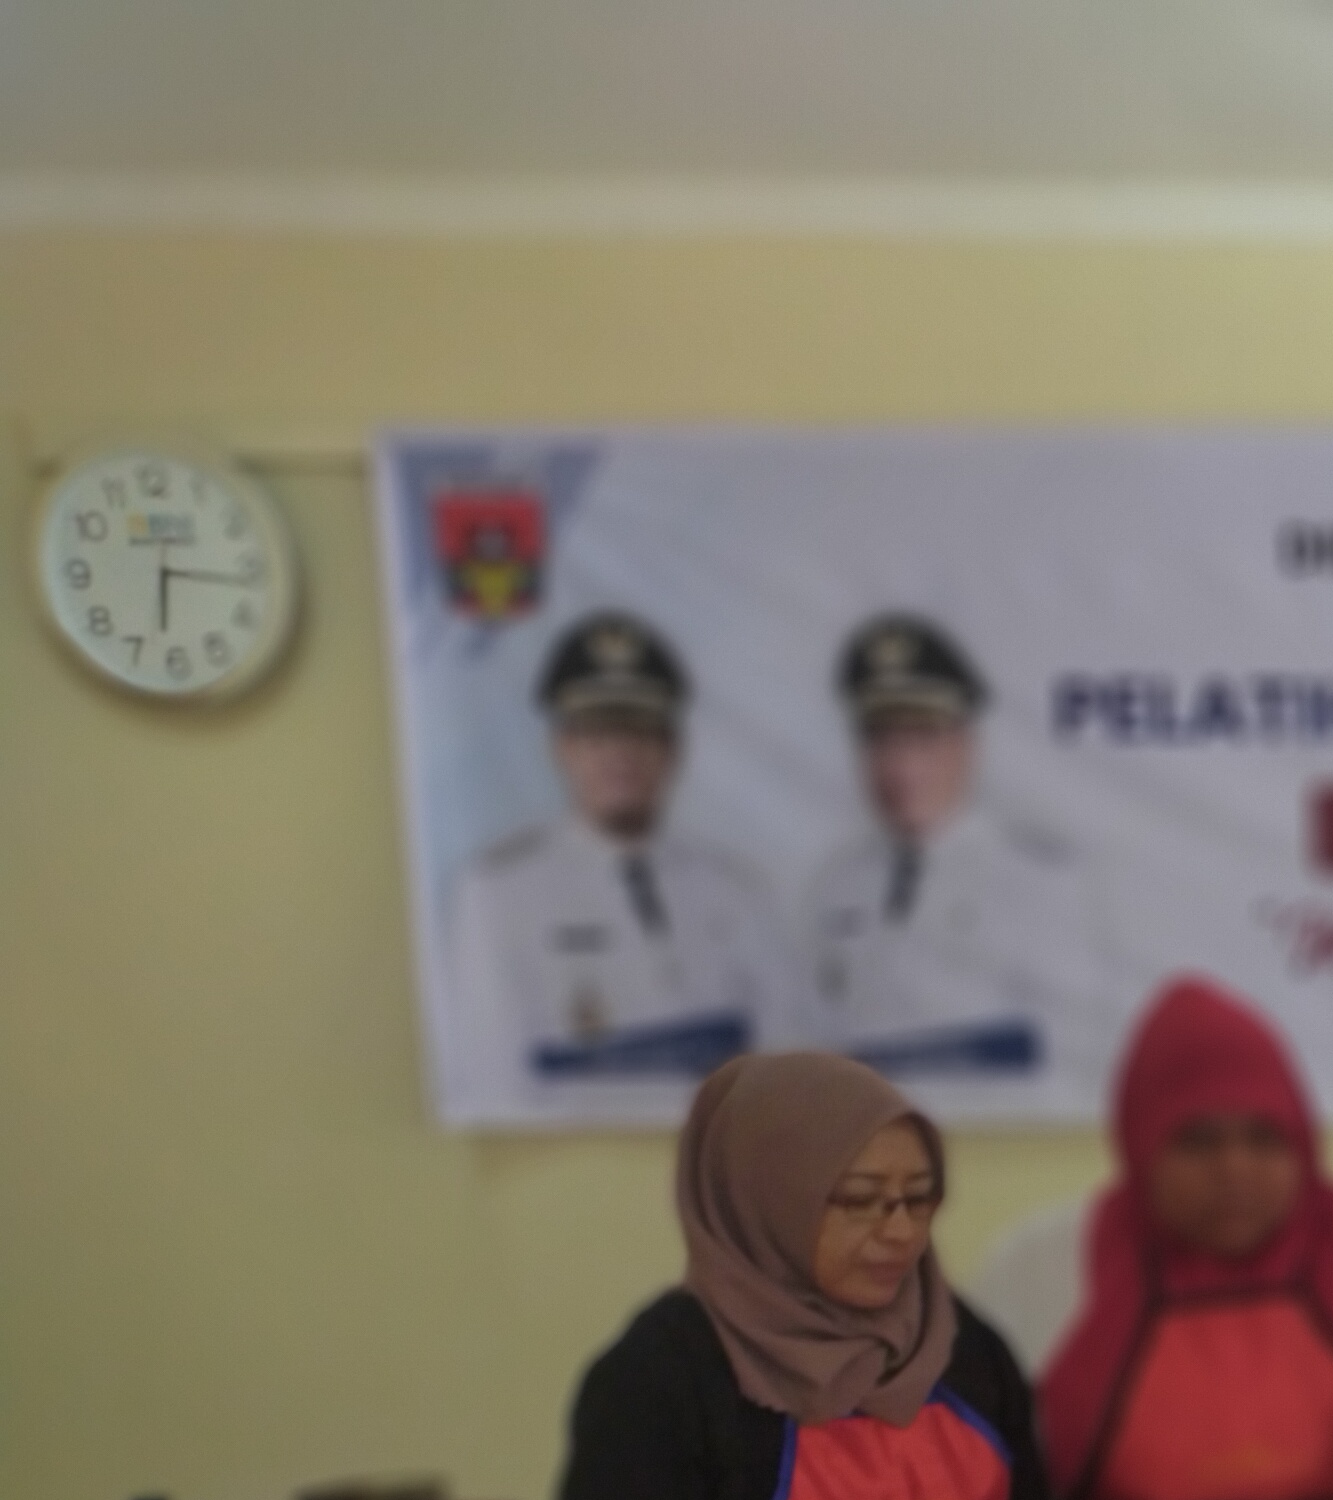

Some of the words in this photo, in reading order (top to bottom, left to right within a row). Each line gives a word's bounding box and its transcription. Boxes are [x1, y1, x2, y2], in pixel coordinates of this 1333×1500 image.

[101, 475, 128, 509] 11
[134, 461, 171, 499] 12
[74, 508, 109, 543] 10
[221, 503, 249, 541] 2
[63, 556, 92, 592] 9
[87, 604, 114, 638] 8
[230, 600, 258, 632] 4
[121, 633, 145, 669] 7
[163, 645, 194, 682] 6
[203, 629, 234, 670] 5
